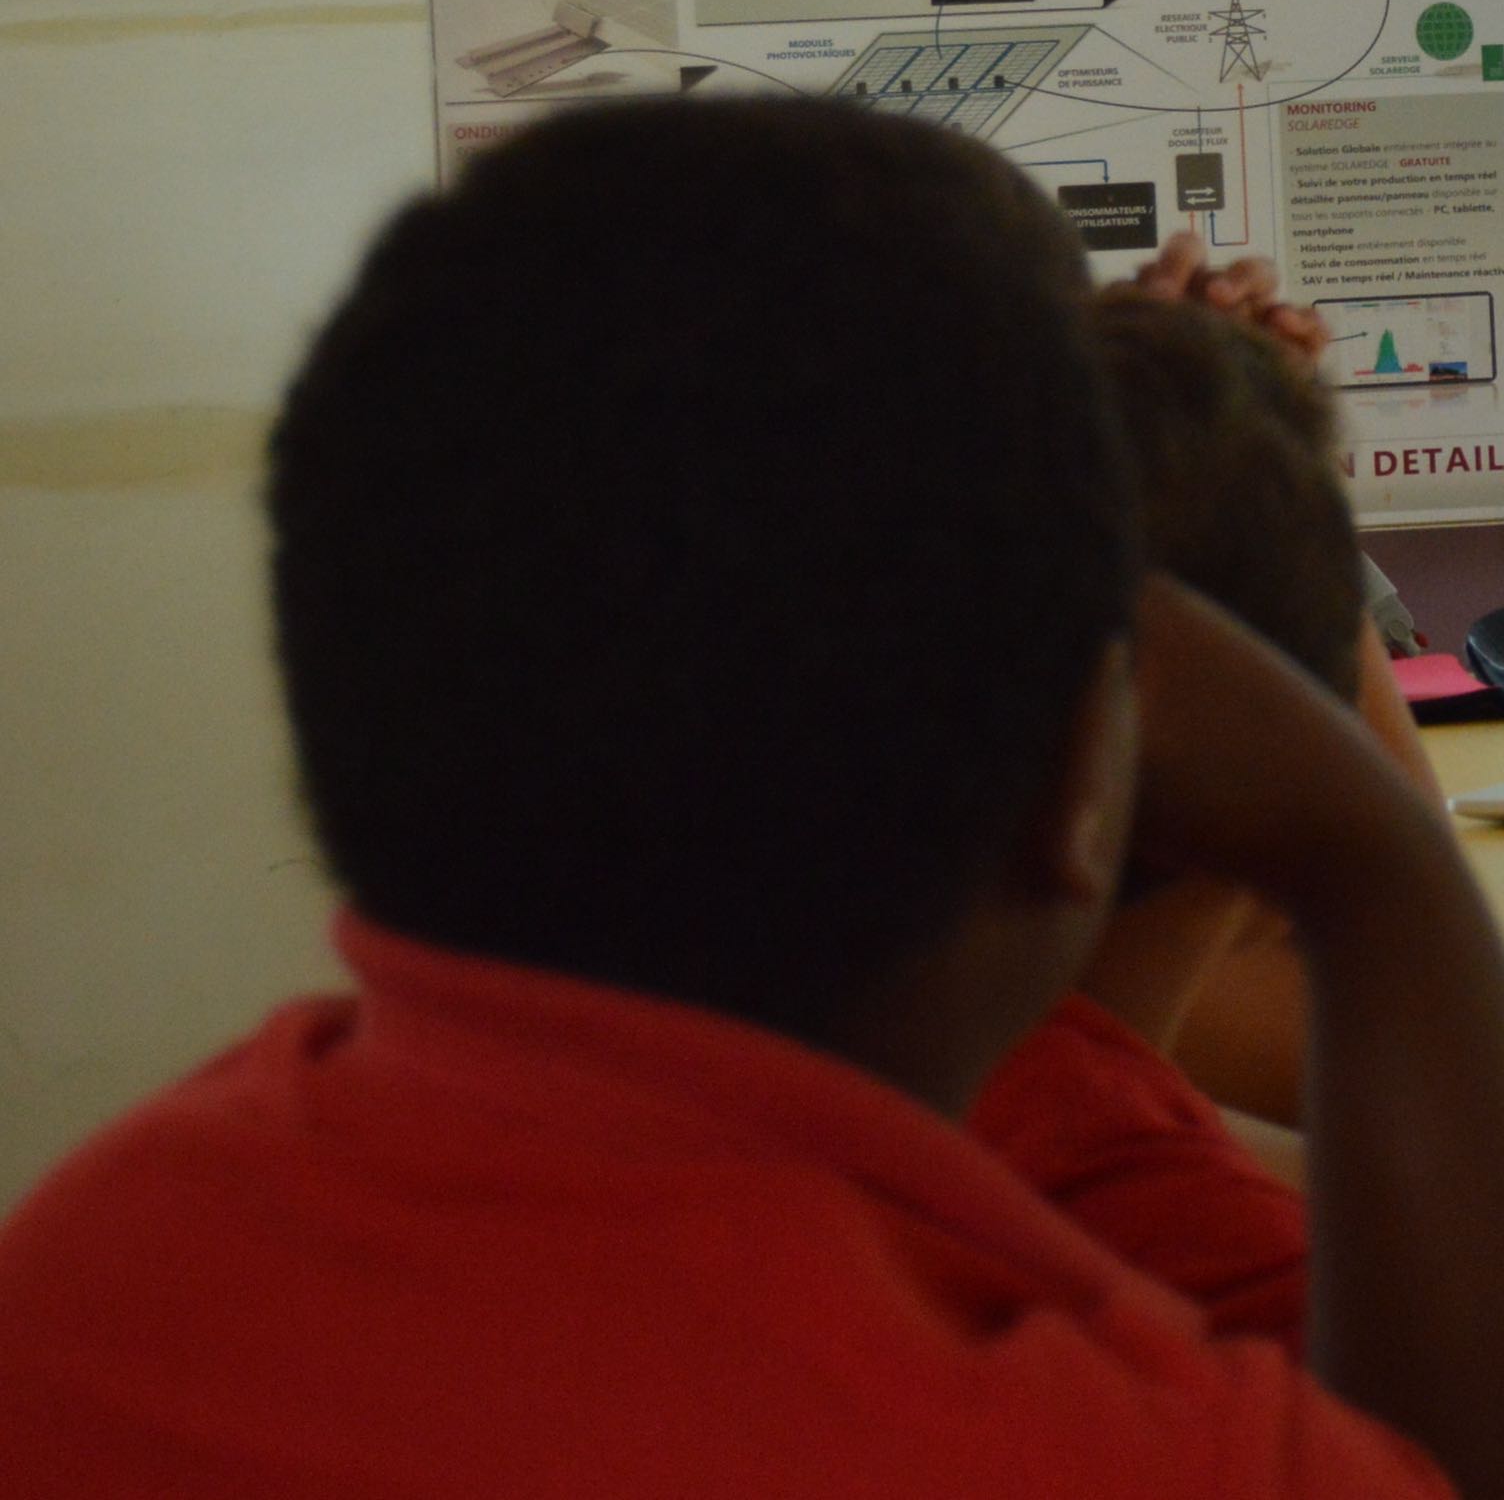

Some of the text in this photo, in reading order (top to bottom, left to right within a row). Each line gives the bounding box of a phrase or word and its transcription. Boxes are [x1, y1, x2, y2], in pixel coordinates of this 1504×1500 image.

[1166, 35, 1199, 44] PUBLIC
[1380, 55, 1420, 65] SERVEUR
[1058, 67, 1119, 77] OPTIMISEURS
[1058, 77, 1122, 89] DE PUISSANCE
[1287, 100, 1376, 116] MONITORING
[1287, 117, 1360, 132] SOLAREDGE
[1400, 157, 1450, 168] GRATUITE
[1371, 174, 1426, 187] production
[1444, 172, 1475, 183] temps
[1478, 171, 1496, 180] réel
[1301, 259, 1326, 269] Suivi
[1329, 259, 1342, 268] de
[1344, 256, 1420, 268] consommation
[1302, 275, 1323, 285] SAV
[1326, 276, 1339, 284] en
[1342, 274, 1372, 285] temps
[1375, 272, 1394, 281] réel
[1405, 268, 1470, 280] Maintenance
[1373, 444, 1504, 477] DETAIL
